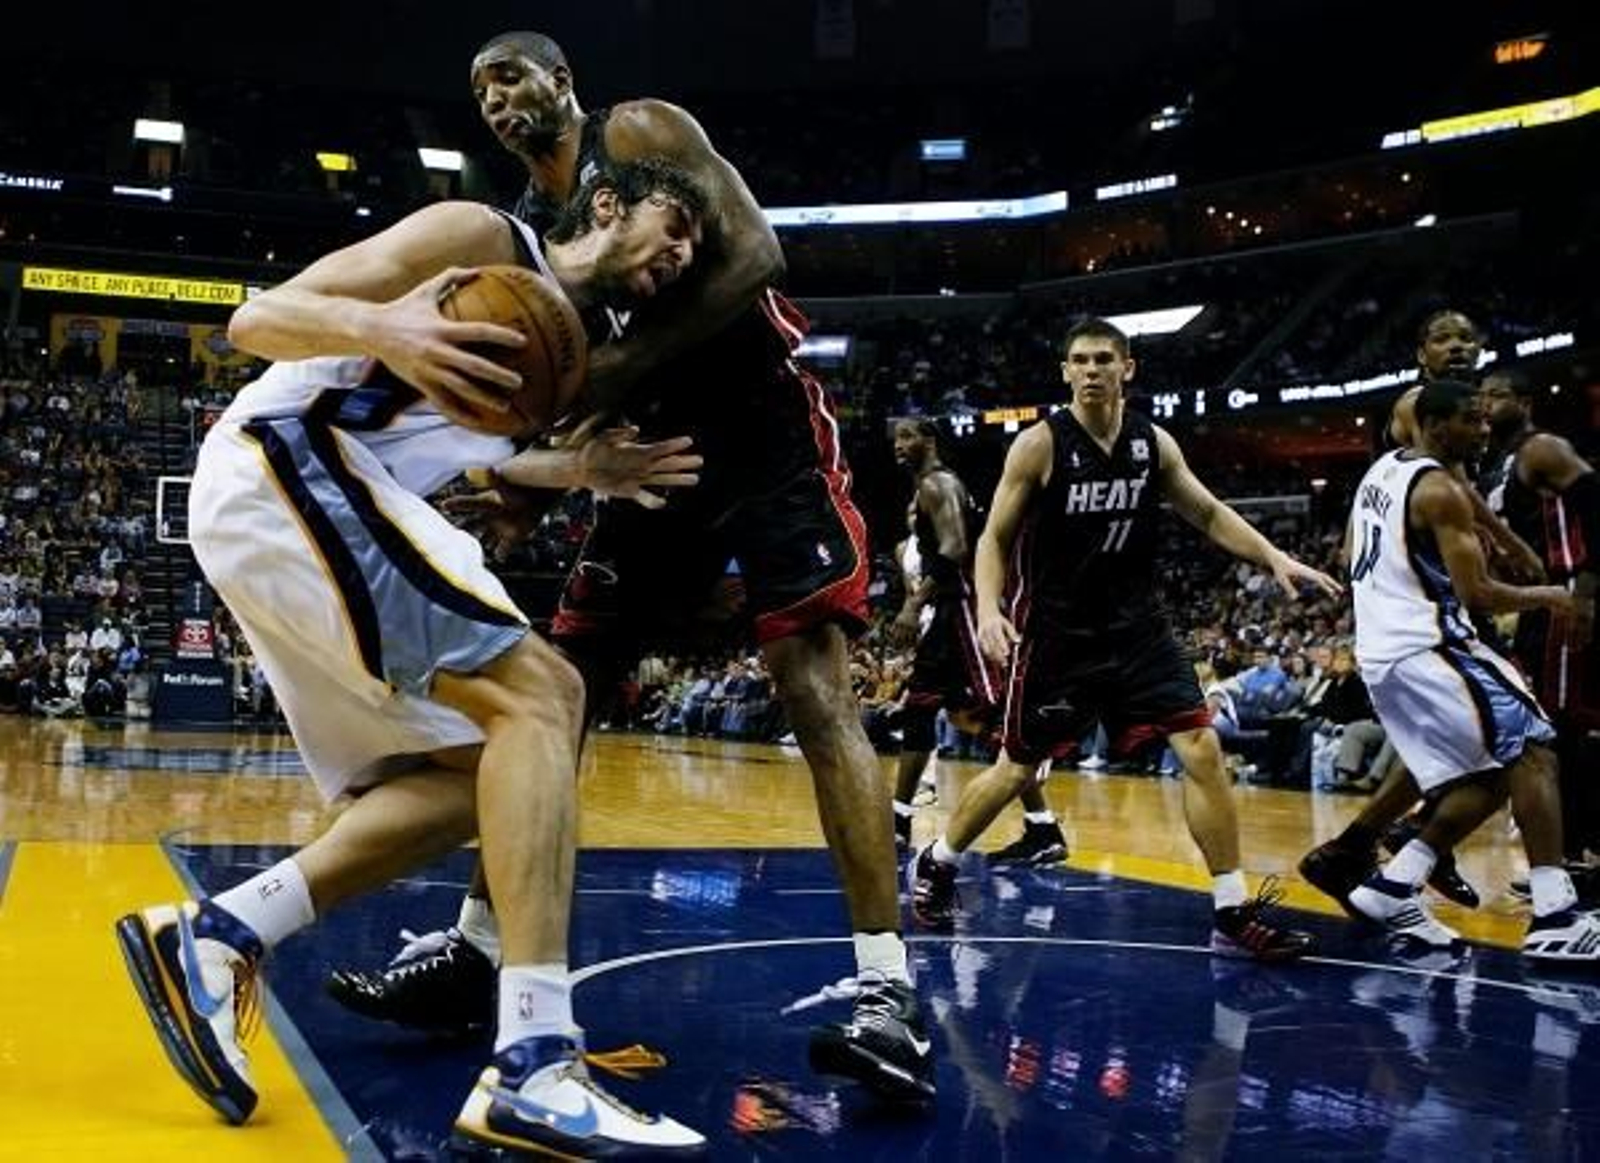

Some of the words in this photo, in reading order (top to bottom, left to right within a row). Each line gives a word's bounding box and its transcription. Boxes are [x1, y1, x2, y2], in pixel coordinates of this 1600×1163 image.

[29, 270, 53, 286] ANY
[105, 277, 130, 293] ANY
[1065, 474, 1148, 514] HEAT
[1102, 519, 1133, 553] 11
